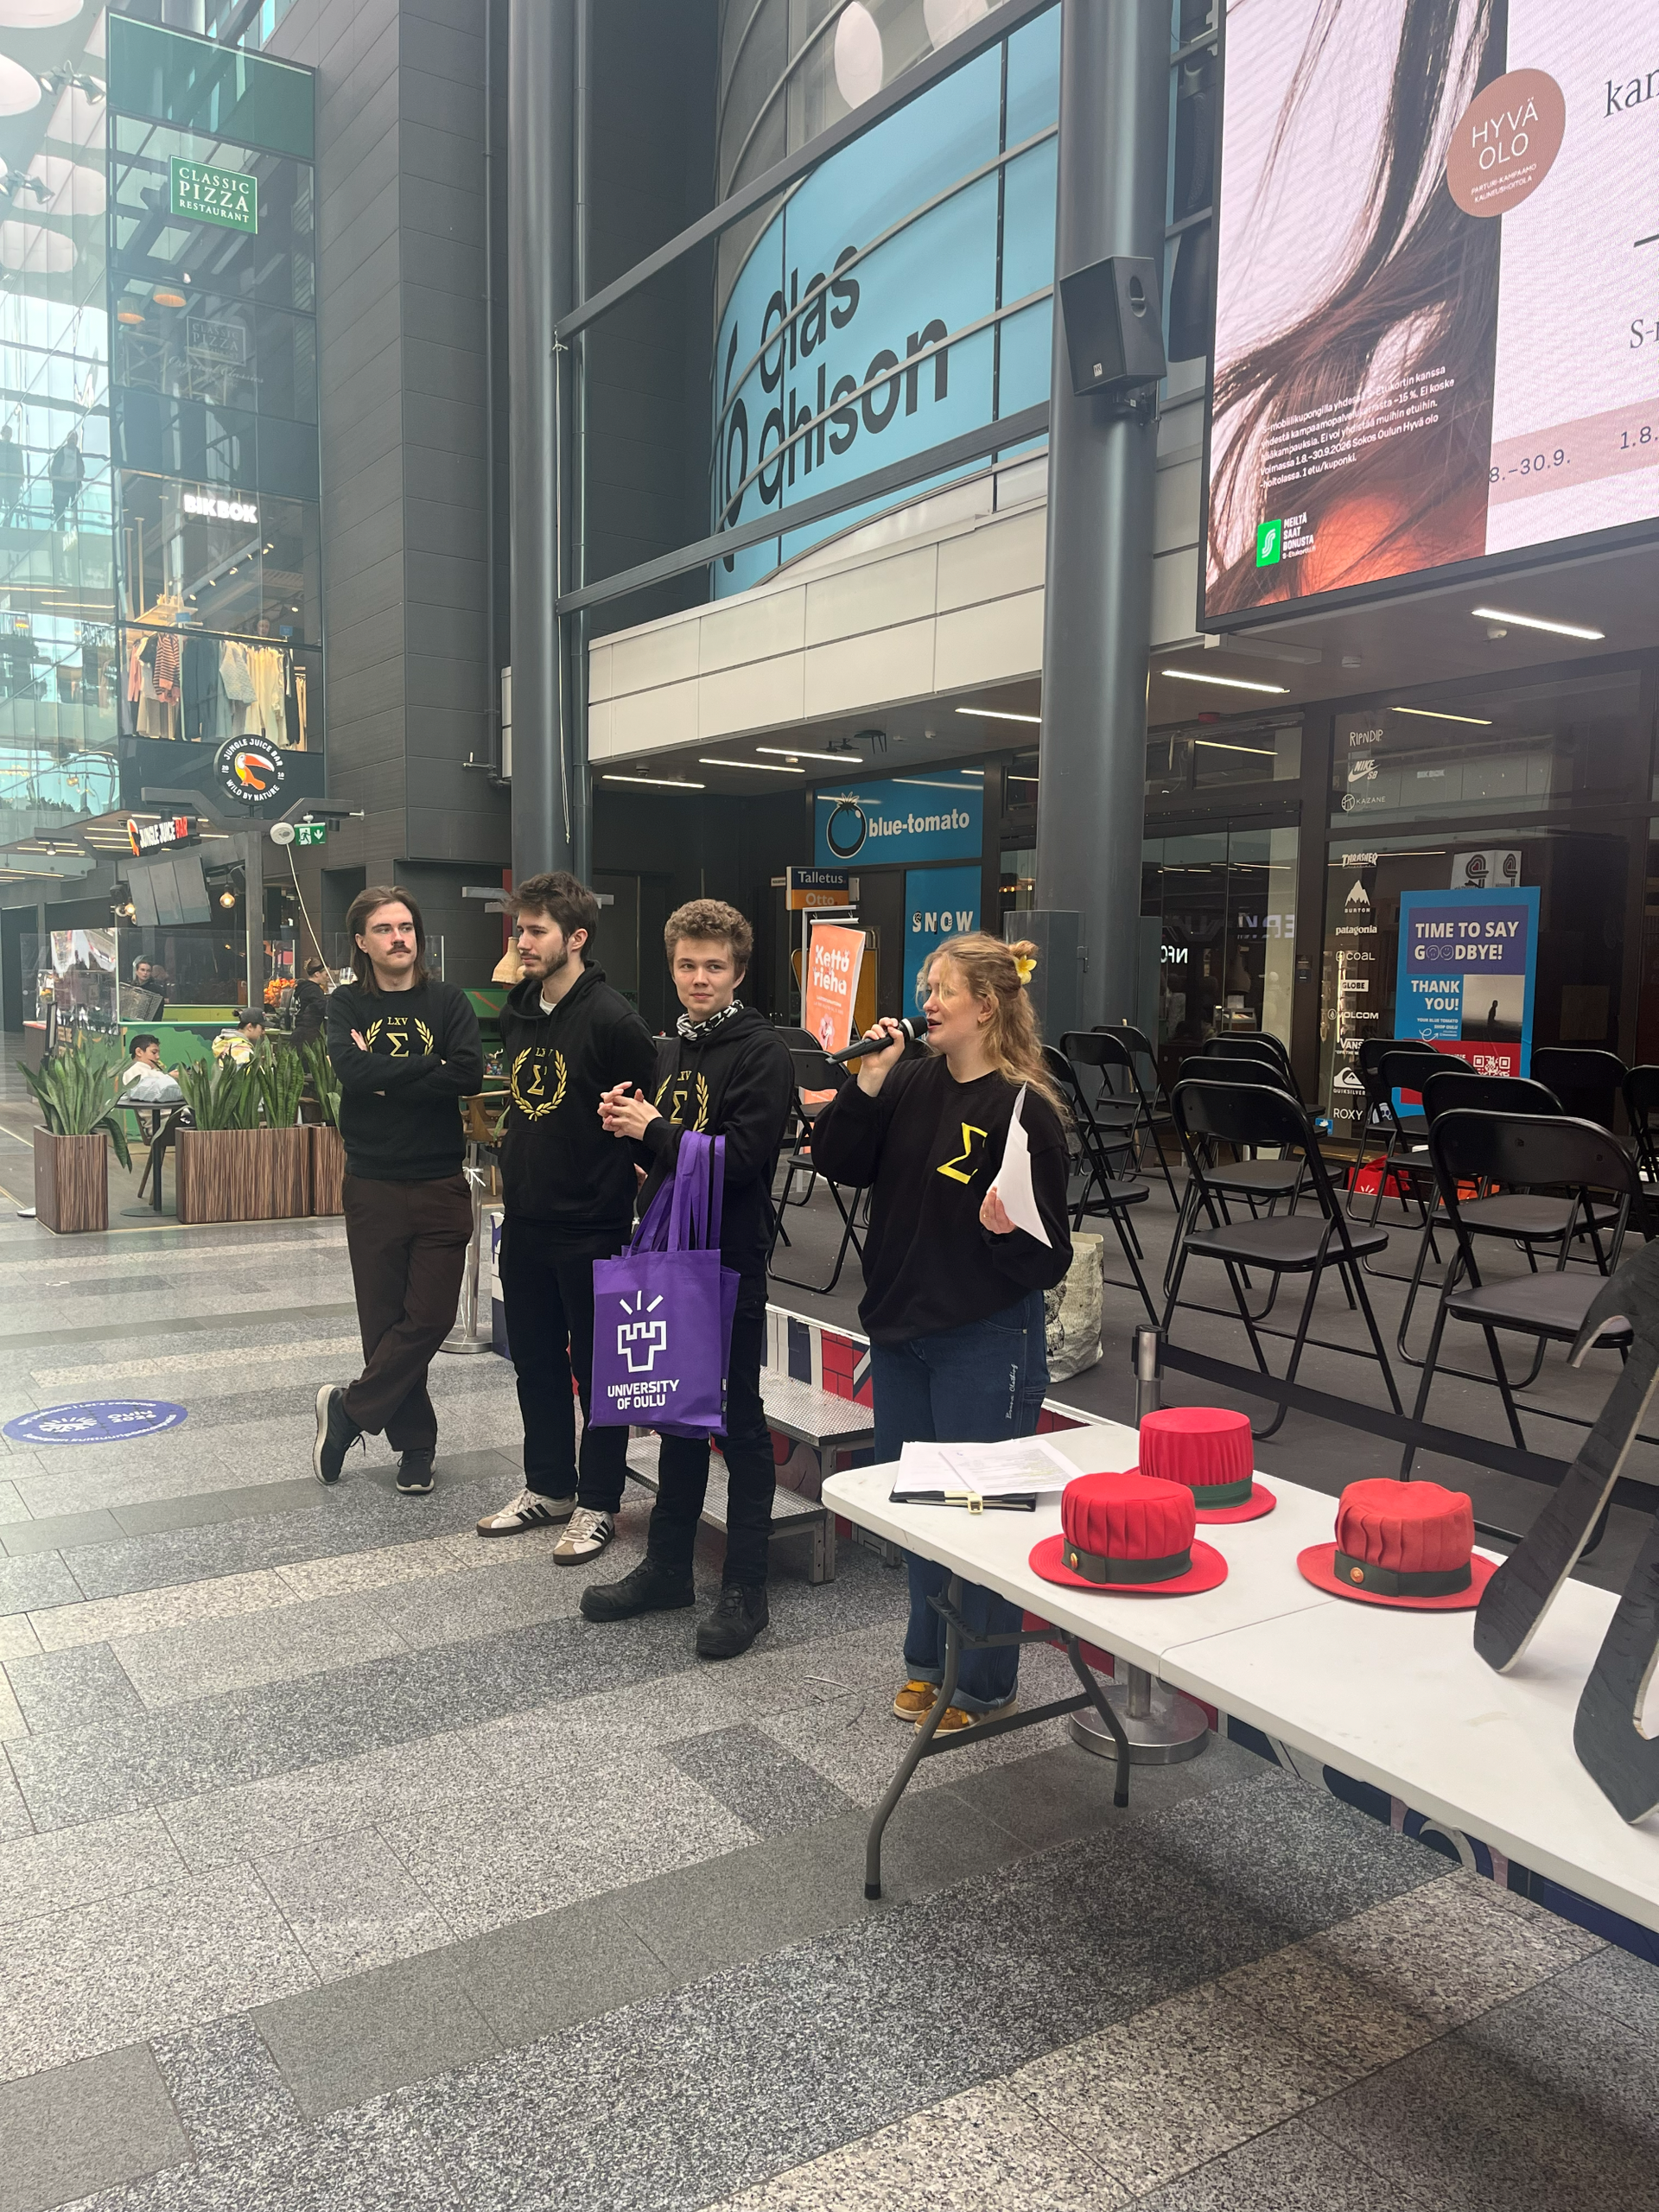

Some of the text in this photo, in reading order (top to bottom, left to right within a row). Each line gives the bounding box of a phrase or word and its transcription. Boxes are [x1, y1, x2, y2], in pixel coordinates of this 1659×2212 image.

[1471, 96, 1538, 148] HYVÄ
[1479, 132, 1529, 170] OLO
[179, 167, 249, 194] CLASSIC
[179, 180, 249, 213] PIZZA
[179, 199, 250, 223] RESTAURANT
[192, 323, 239, 340] CLASSIC
[193, 332, 238, 352] PIZZA
[1415, 365, 1446, 383] kanssa
[1421, 385, 1428, 397] Ei
[1430, 378, 1455, 394] koske
[1320, 433, 1328, 443] Ei
[1329, 429, 1340, 440] voi
[1376, 409, 1405, 425] muihin
[1406, 399, 1438, 416] etuihin.
[1352, 433, 1376, 448] Sokos
[1377, 425, 1402, 440] Oulun
[1403, 419, 1424, 432] Hyvä
[1425, 413, 1439, 425] olo
[1302, 467, 1307, 477] 1
[1283, 511, 1307, 530] MEILTÄ
[1283, 526, 1301, 540] SAAT
[1282, 534, 1314, 551] BONUSTA
[1350, 729, 1383, 747] RIPNDIP
[224, 738, 283, 766] JUNGLE JUICE BAR
[1354, 759, 1375, 772] NIKE
[1367, 771, 1378, 780] SB
[226, 779, 280, 801] WILD BY NATURE
[1356, 796, 1386, 804] KAZANE
[139, 815, 188, 849] JUNGLE JUICE BAR
[868, 809, 969, 837] blue-tomato
[1342, 852, 1378, 868] THRASHER
[912, 911, 974, 934] SNOW
[1335, 925, 1378, 936] patagonia
[1415, 921, 1519, 938] TIME TO SAY
[813, 966, 848, 995] rieha
[1411, 980, 1460, 994] THANK
[1425, 997, 1459, 1011] YOU!
[387, 1016, 408, 1026] LXV
[1338, 1011, 1379, 1020] VOLCOM
[1340, 1038, 1364, 1050] VANS
[1333, 1108, 1363, 1121] ROXY
[1009, 1363, 1018, 1392] Clothing
[607, 1379, 680, 1397] UNIVERSITY
[617, 1394, 666, 1410] OF OULU
[111, 1414, 157, 1423] 2026
